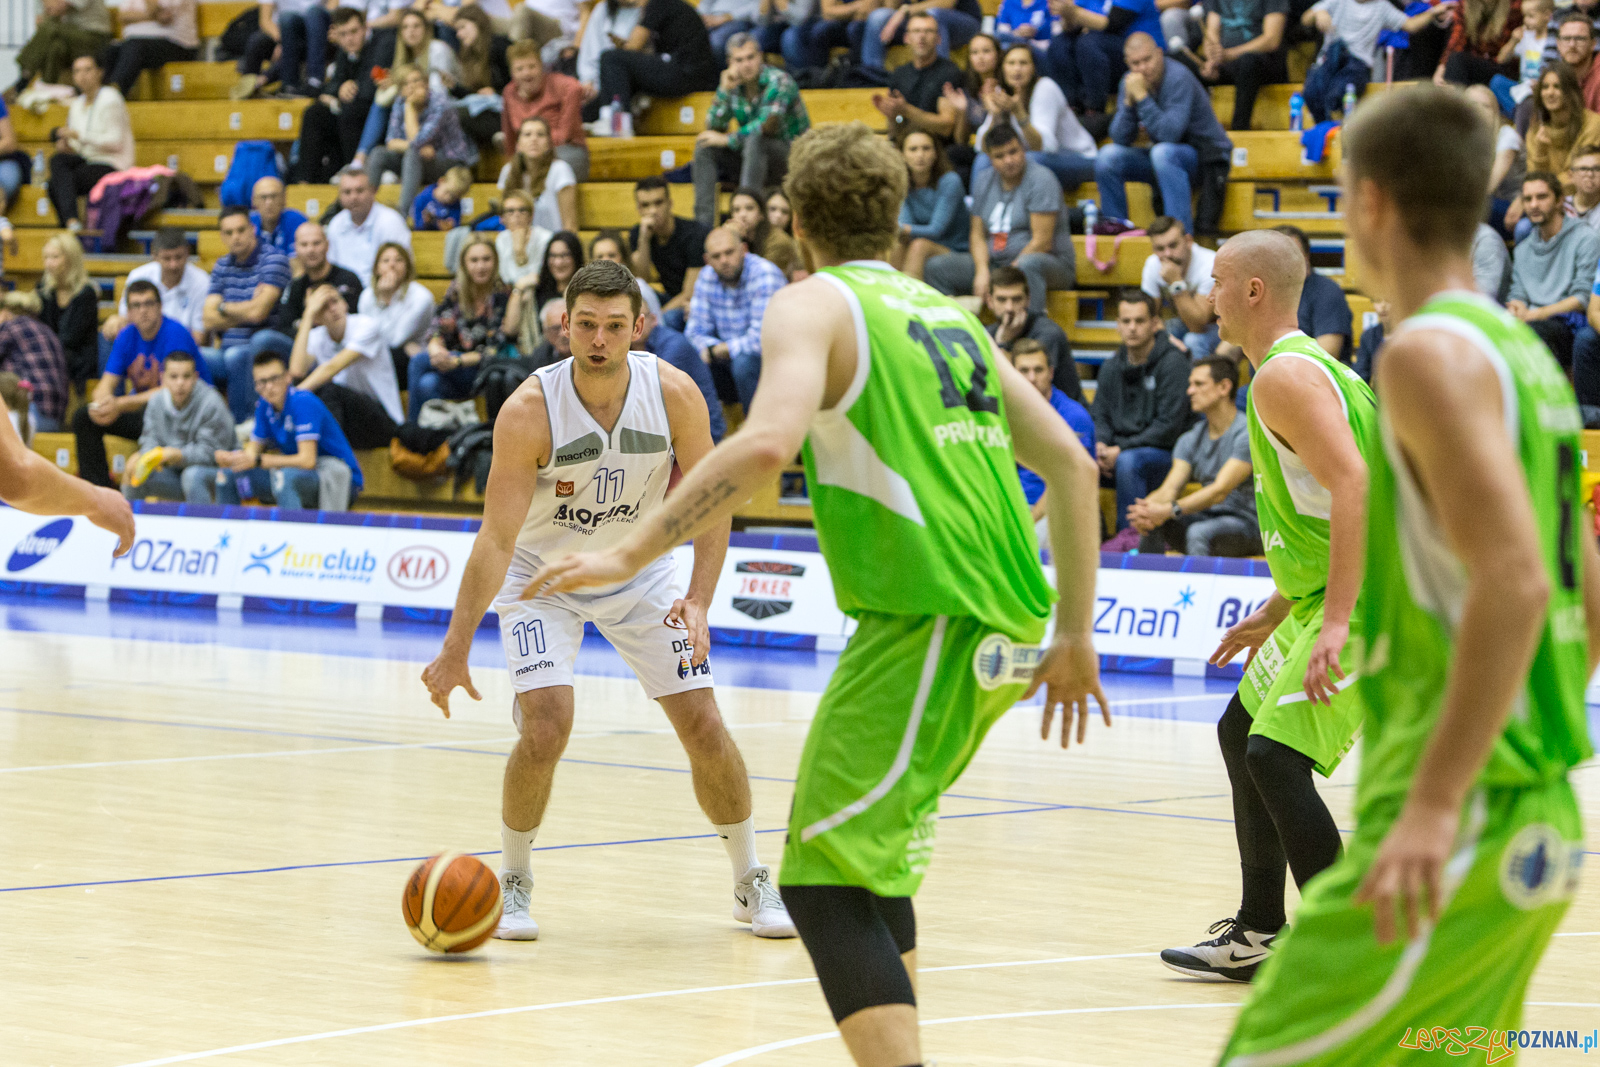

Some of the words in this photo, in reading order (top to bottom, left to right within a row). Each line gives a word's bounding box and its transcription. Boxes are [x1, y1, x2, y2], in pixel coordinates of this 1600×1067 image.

[908, 320, 999, 415] 12
[556, 447, 599, 463] macron
[593, 467, 625, 504] 11
[283, 545, 376, 573] funclub
[398, 555, 437, 580] KIA
[740, 577, 791, 598] JOKER
[512, 619, 546, 657] 11
[515, 660, 554, 677] macron
